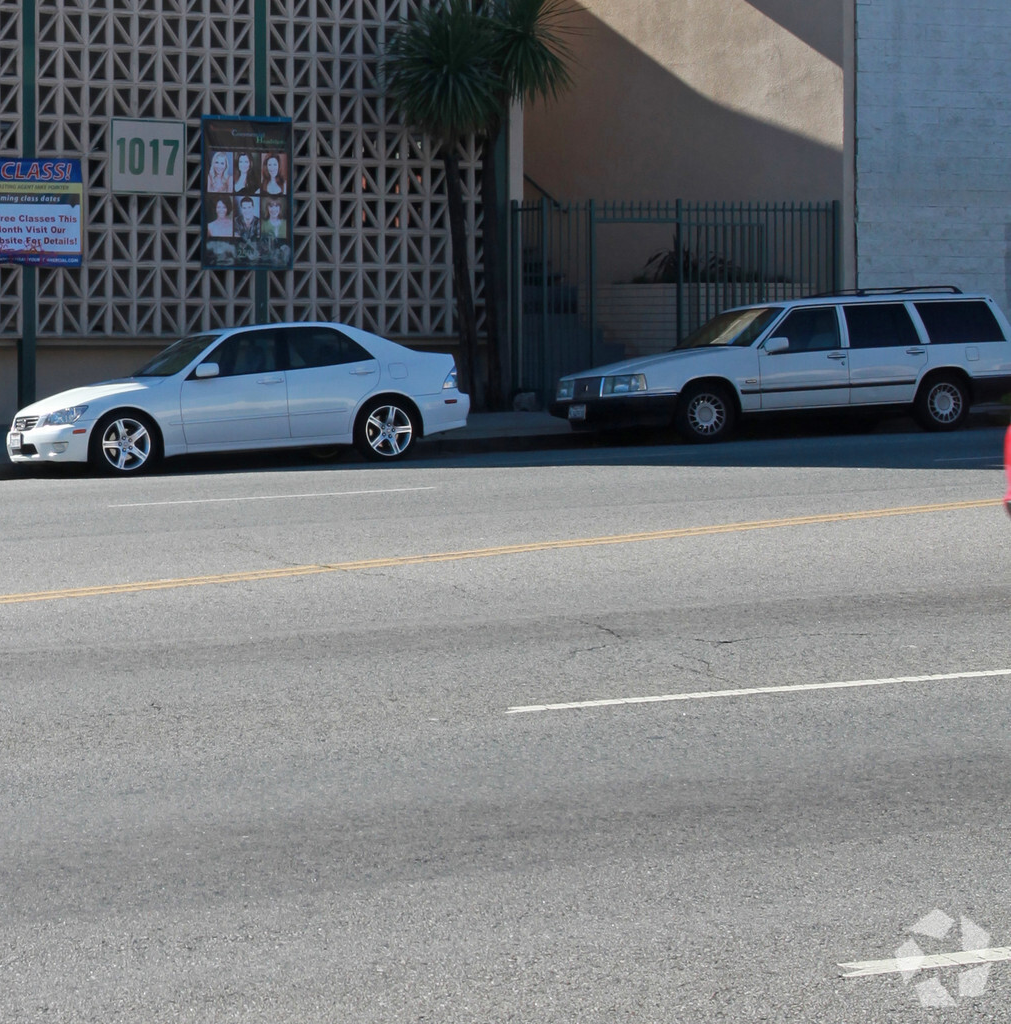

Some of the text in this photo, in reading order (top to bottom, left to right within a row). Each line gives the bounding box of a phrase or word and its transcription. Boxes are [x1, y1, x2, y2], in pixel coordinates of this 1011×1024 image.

[116, 137, 180, 176] 1017
[1, 161, 72, 181] CLASS!
[40, 195, 61, 203] dates
[18, 214, 56, 223] Classes
[58, 215, 77, 223] This
[26, 226, 48, 234] Visit
[26, 237, 41, 246] For
[43, 237, 78, 246] Details!
